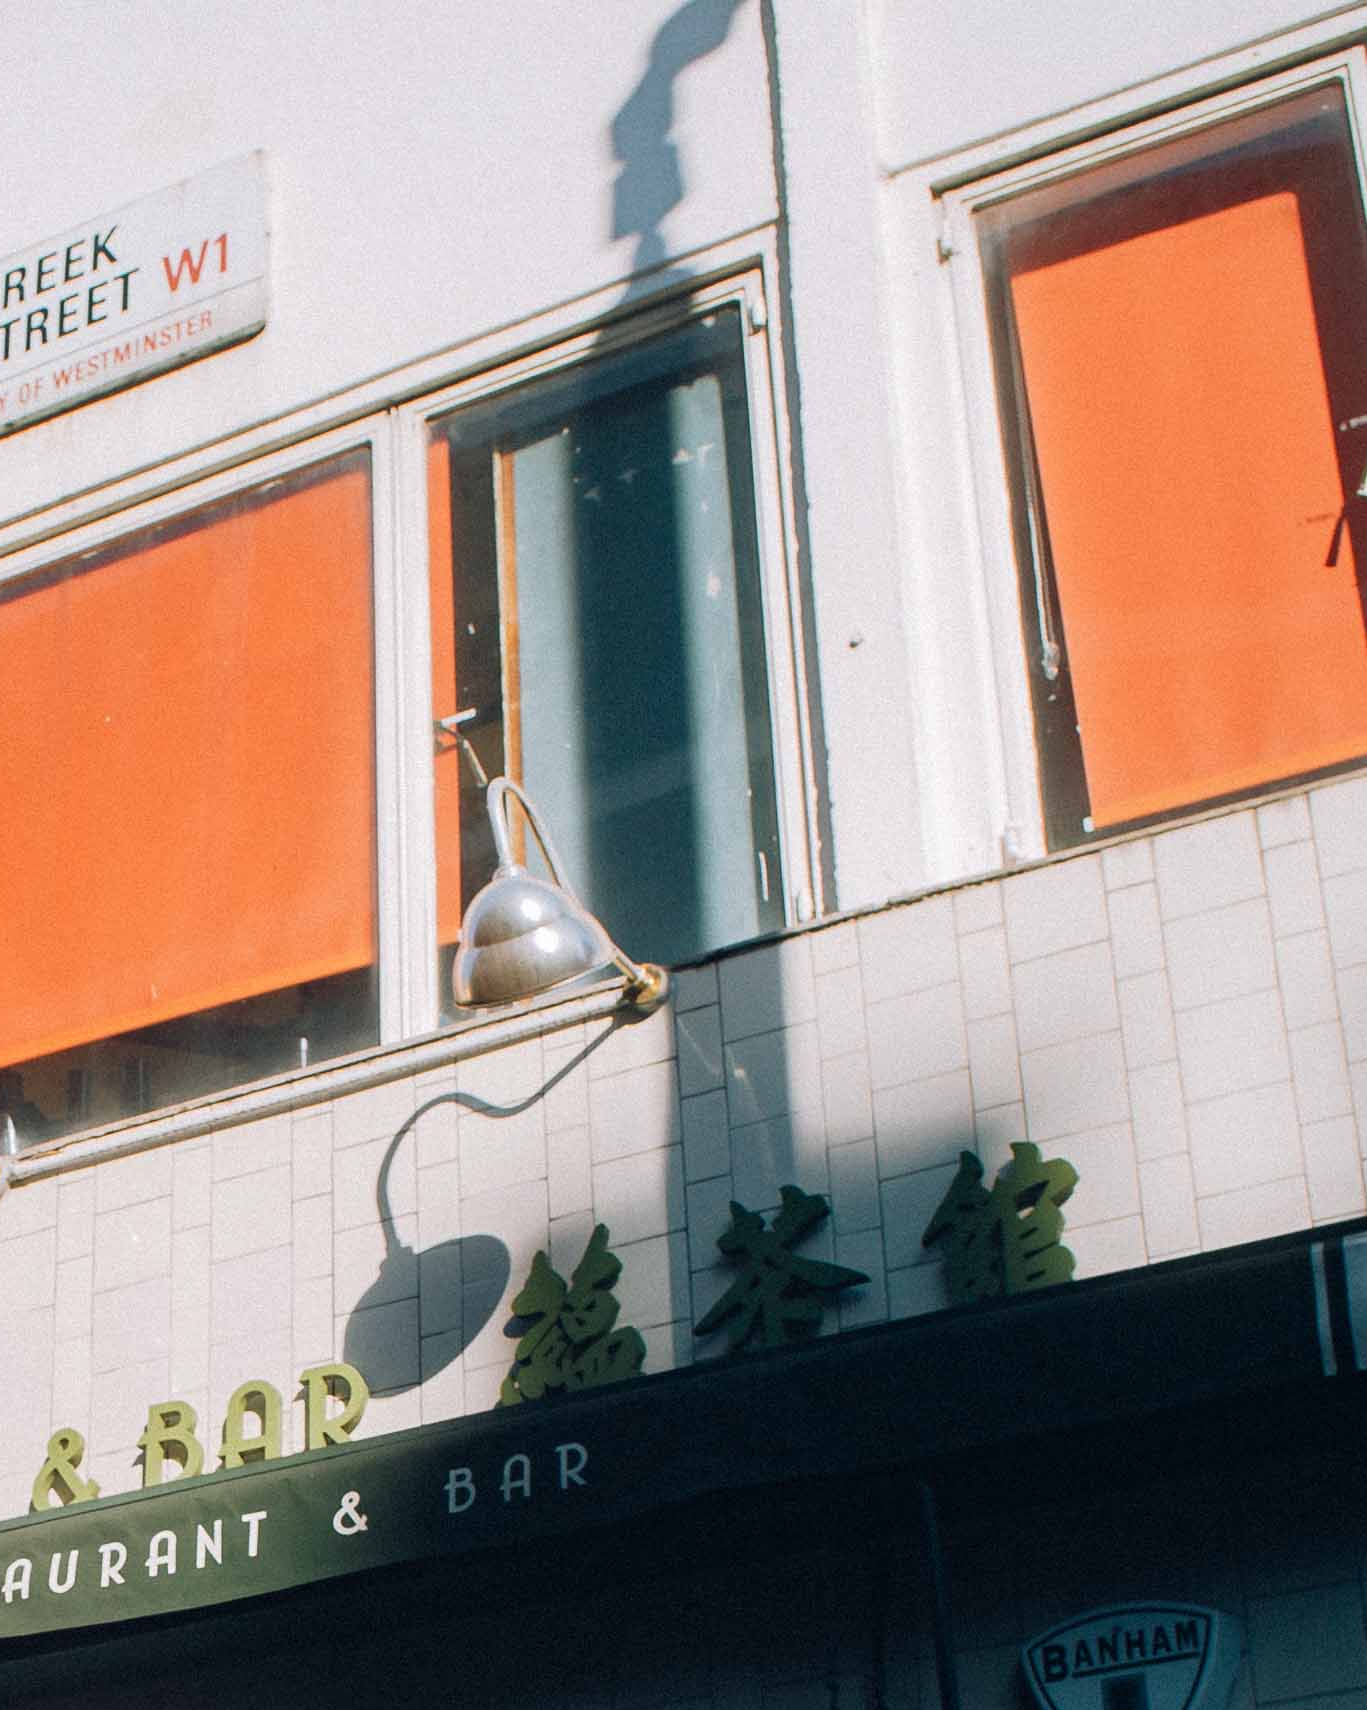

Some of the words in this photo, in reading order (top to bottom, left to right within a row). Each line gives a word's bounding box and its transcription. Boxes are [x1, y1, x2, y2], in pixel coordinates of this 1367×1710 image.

[162, 232, 229, 294] W1
[17, 377, 44, 408] OF
[52, 309, 214, 391] WESTMINSTER
[30, 1427, 101, 1514] &
[132, 1362, 371, 1488] BAR
[332, 1490, 369, 1537] &
[443, 1442, 589, 1514] BAR
[1040, 1619, 1199, 1684] BANHAM
